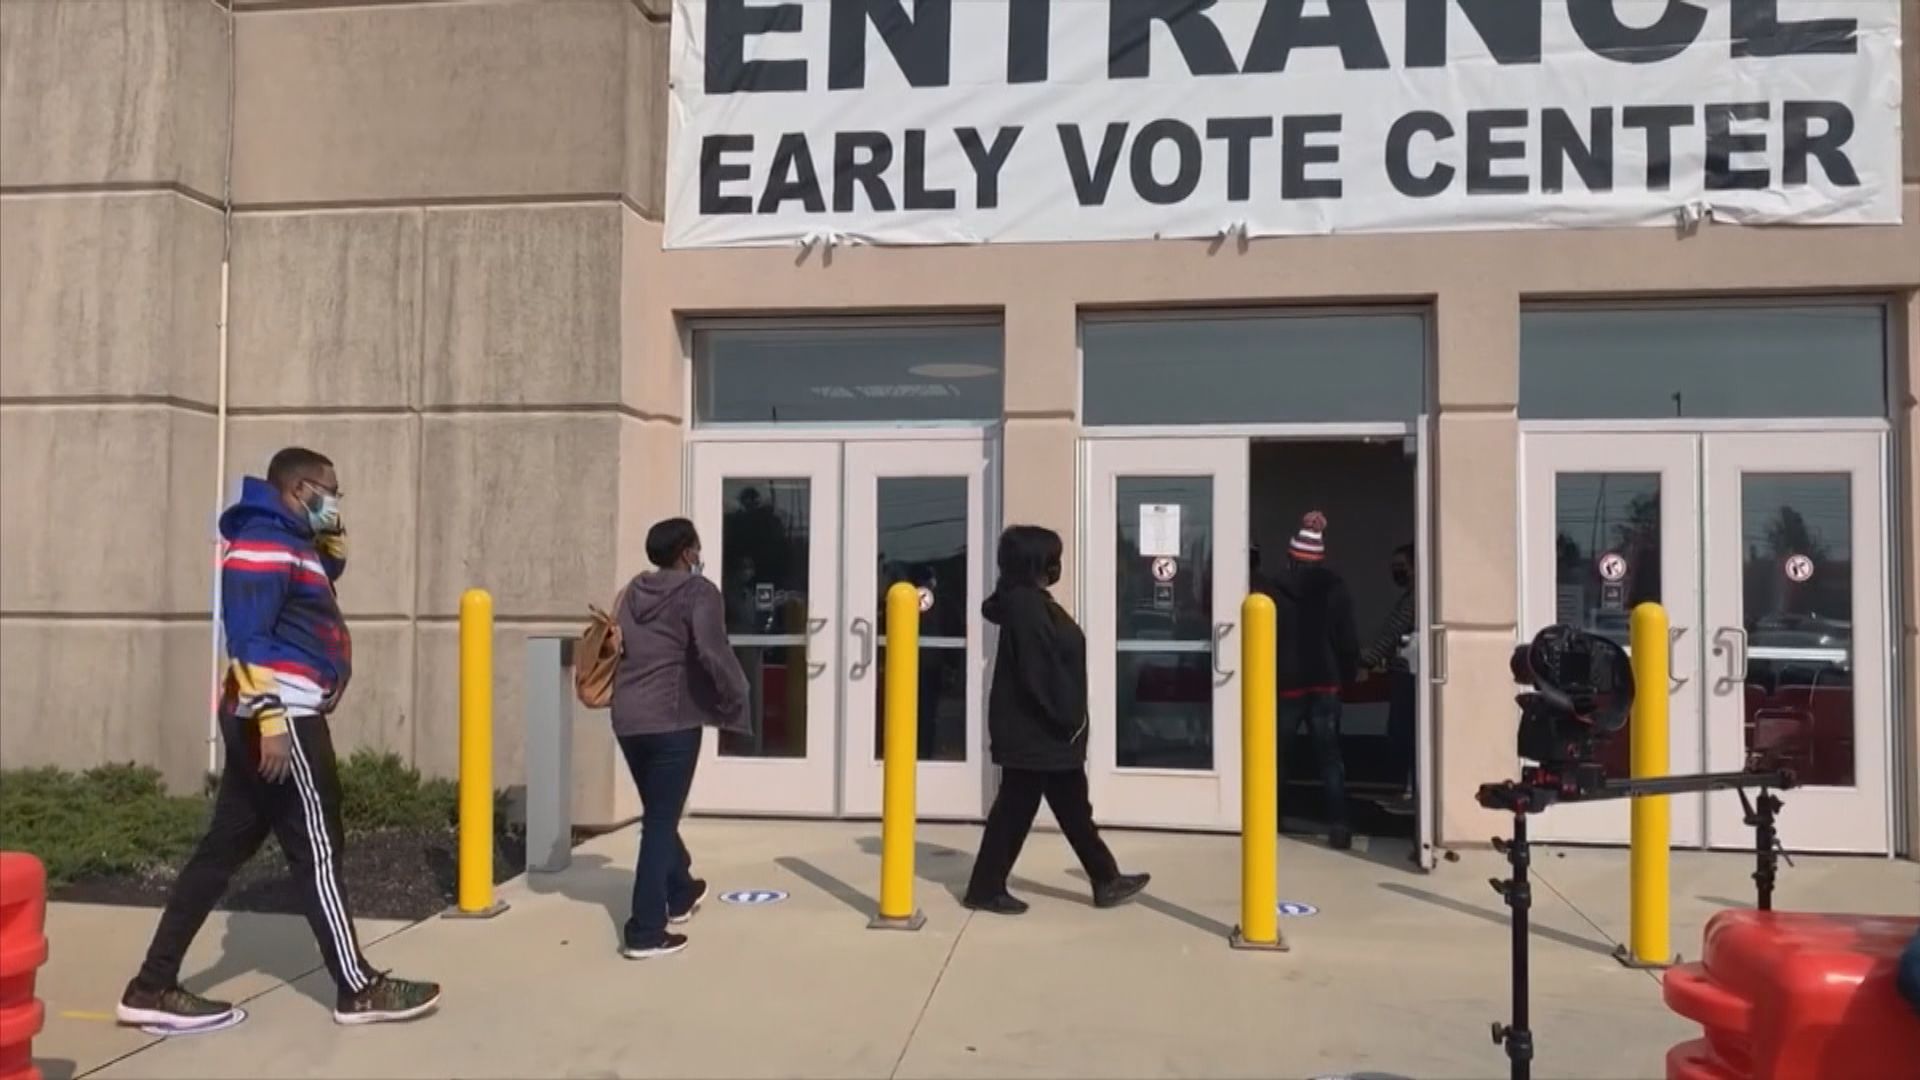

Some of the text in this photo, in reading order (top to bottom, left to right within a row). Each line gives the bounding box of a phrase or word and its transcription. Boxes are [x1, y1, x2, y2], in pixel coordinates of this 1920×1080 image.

[699, 100, 1861, 215] EARLY VOTE CENTER
